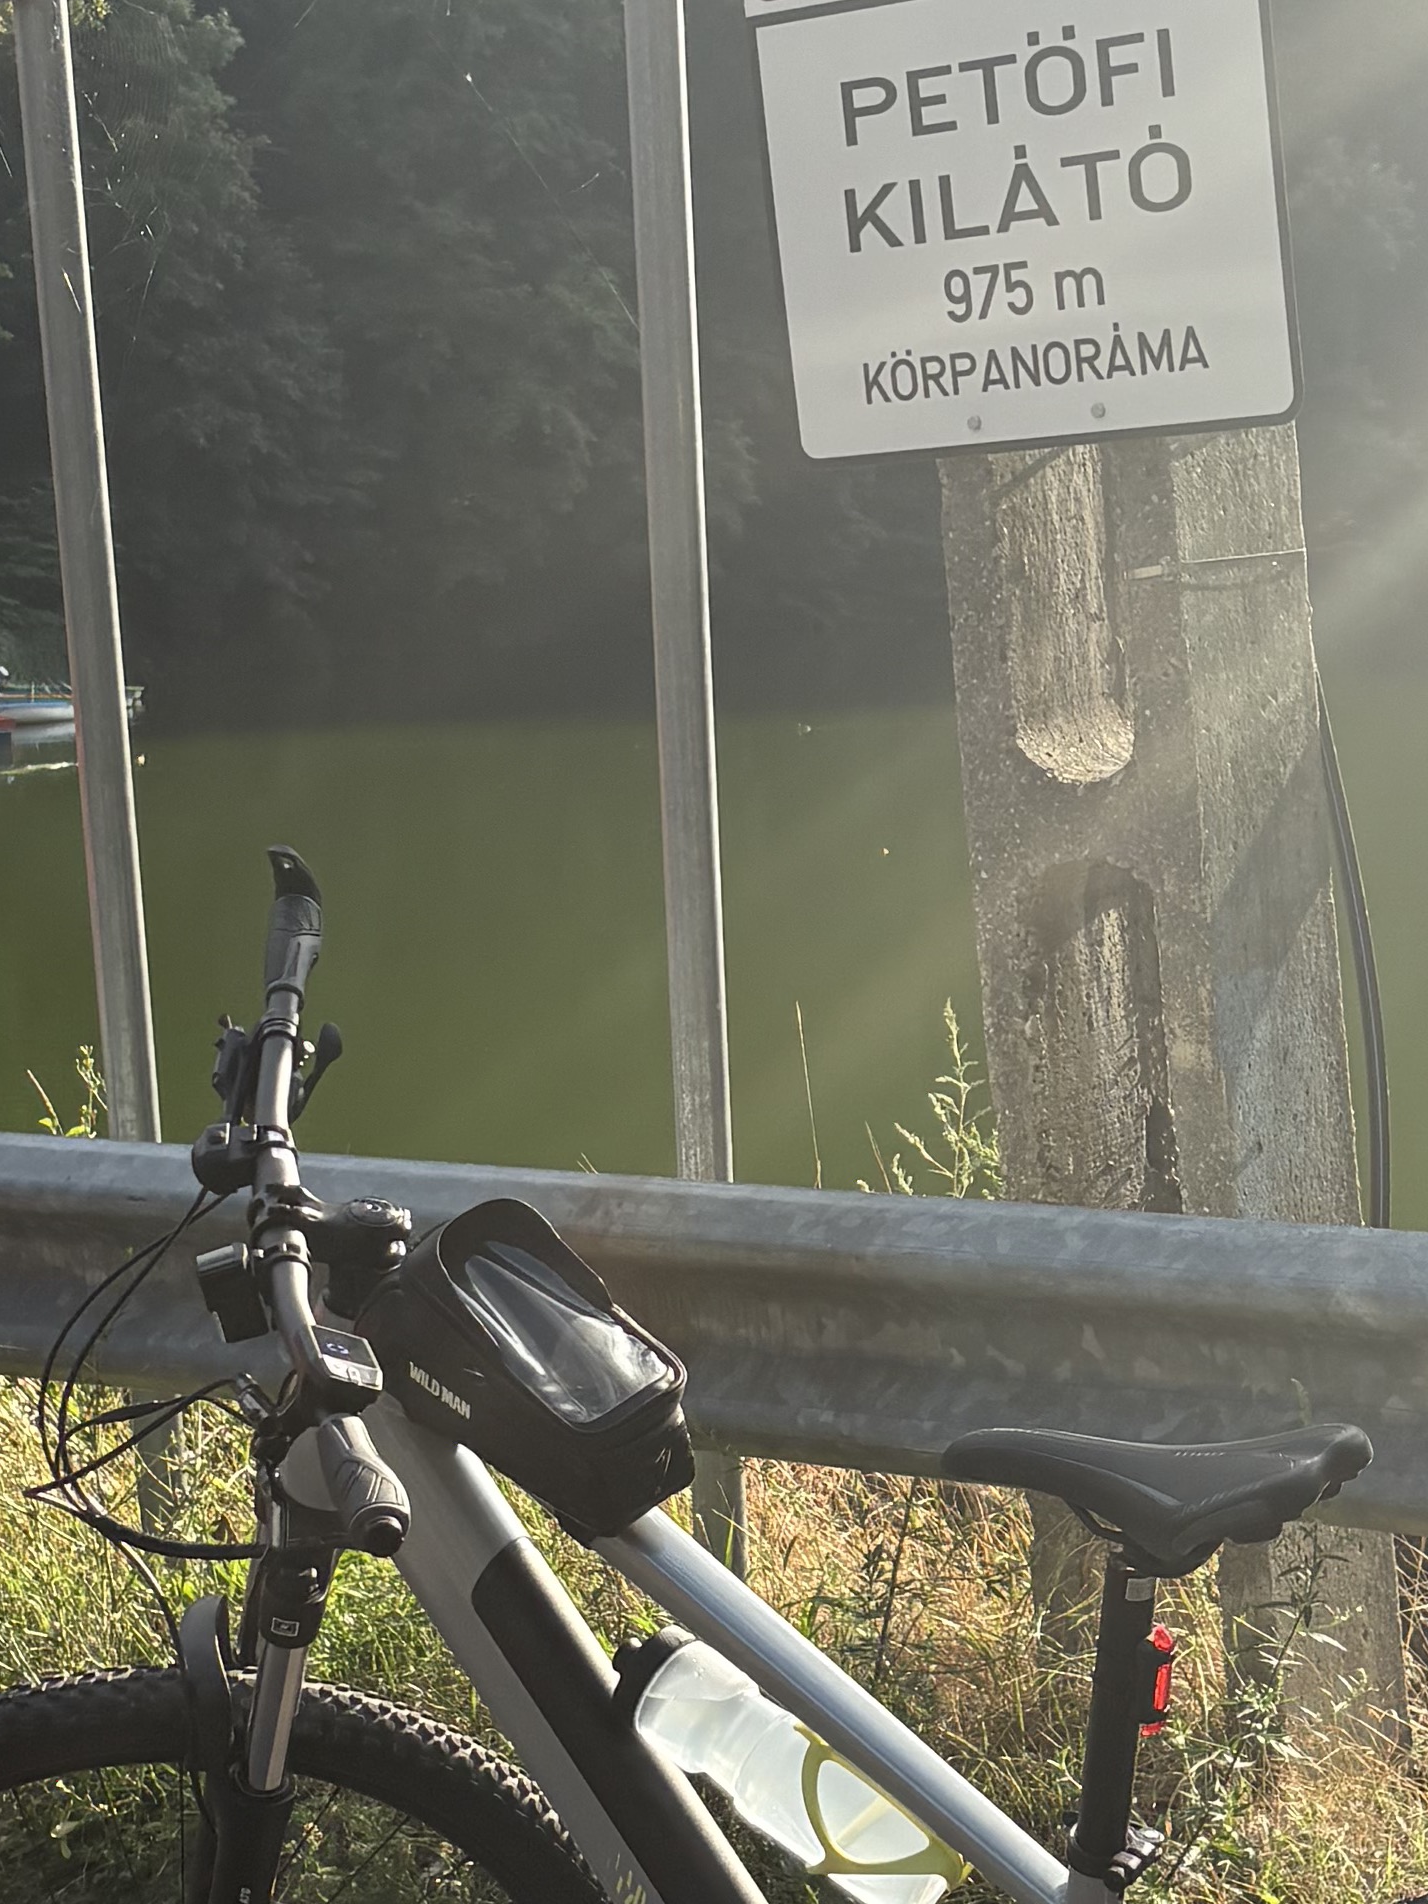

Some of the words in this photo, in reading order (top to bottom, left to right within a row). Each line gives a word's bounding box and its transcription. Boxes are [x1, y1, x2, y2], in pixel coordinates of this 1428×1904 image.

[843, 125, 1193, 254] KILÁTÓ
[944, 261, 1035, 323] 975
[1056, 264, 1106, 310] m
[862, 324, 1210, 404] KÖRPANORÁMA
[409, 1360, 440, 1397] WILD
[441, 1385, 471, 1420] MAN
